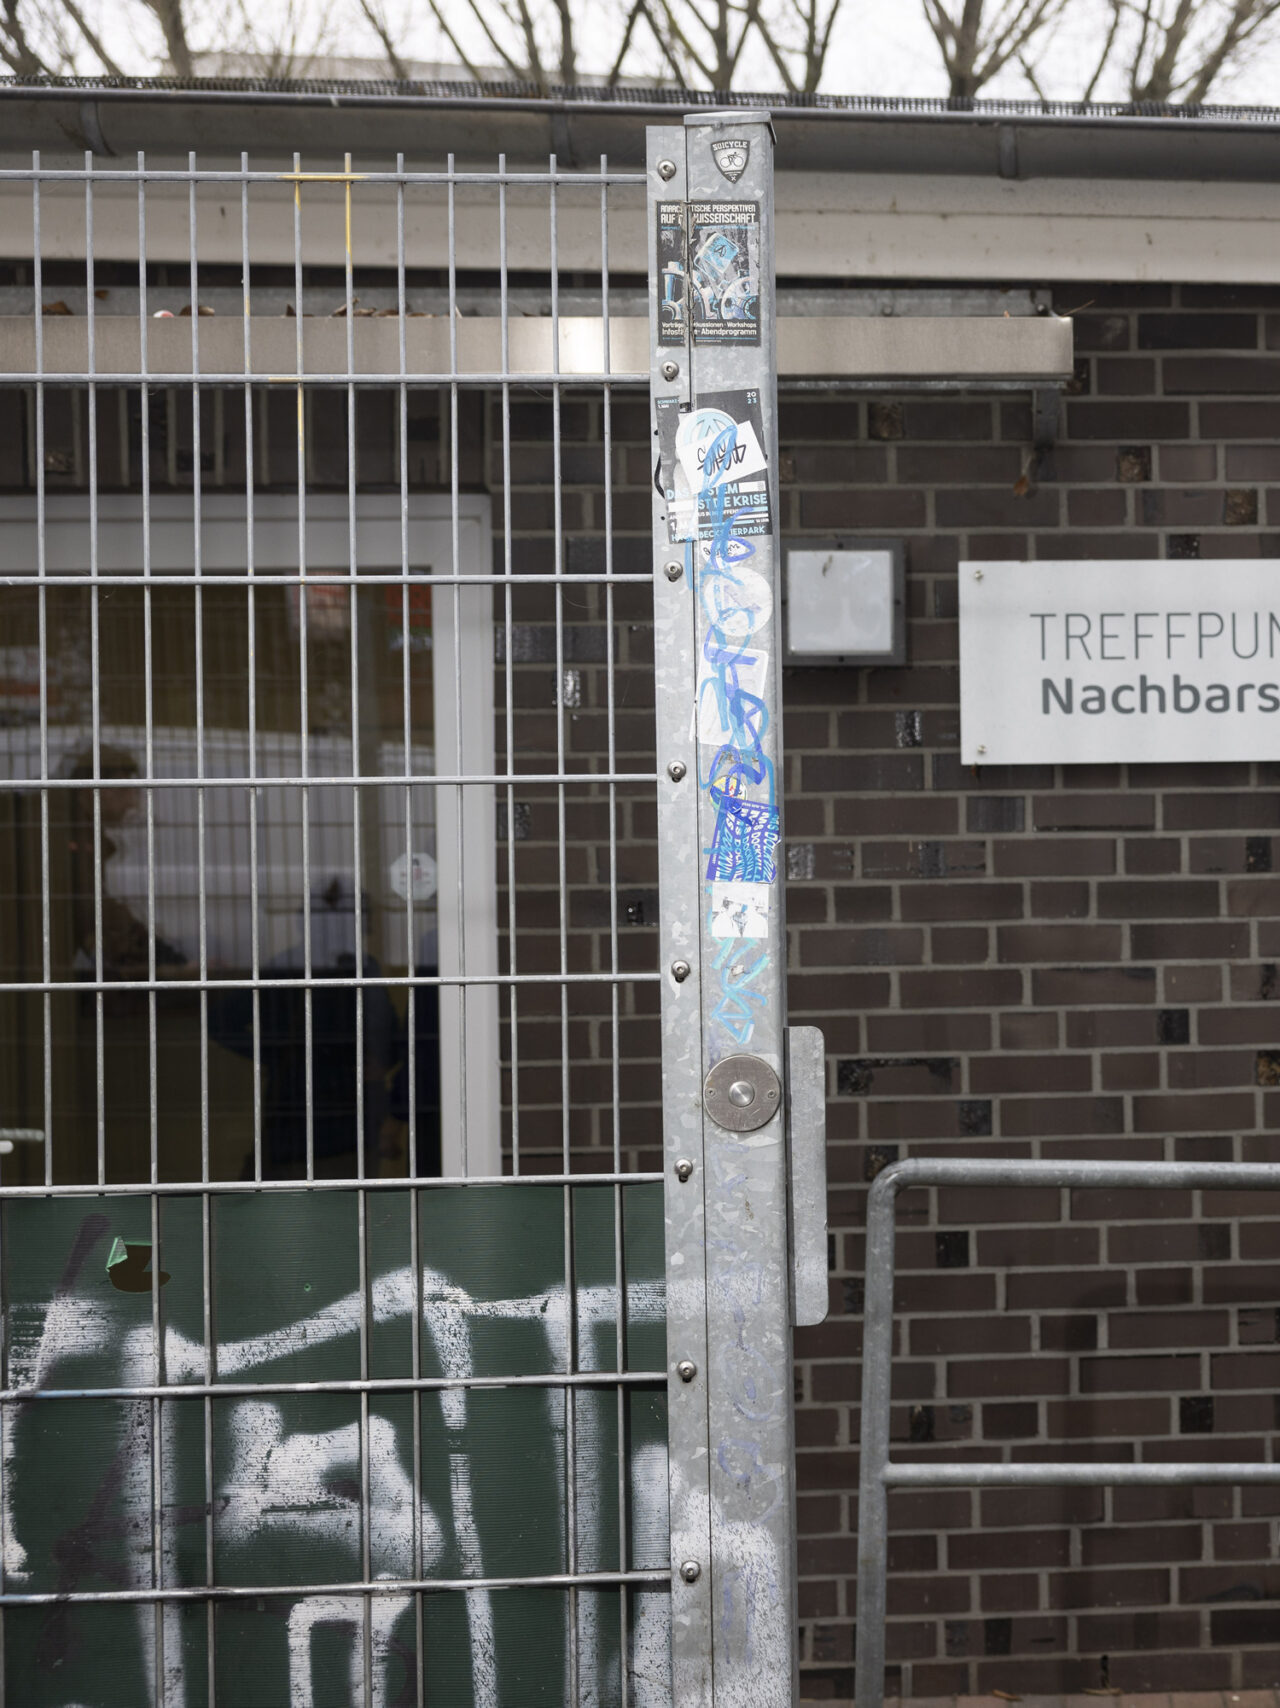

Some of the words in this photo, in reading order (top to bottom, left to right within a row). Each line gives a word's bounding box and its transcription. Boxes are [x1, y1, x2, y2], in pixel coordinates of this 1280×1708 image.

[712, 204, 756, 212] PERSPEKTIVEN
[661, 214, 676, 224] AUF
[727, 321, 757, 330] Workshops
[701, 327, 757, 337] Abendprogramm
[733, 494, 767, 507] KRISE
